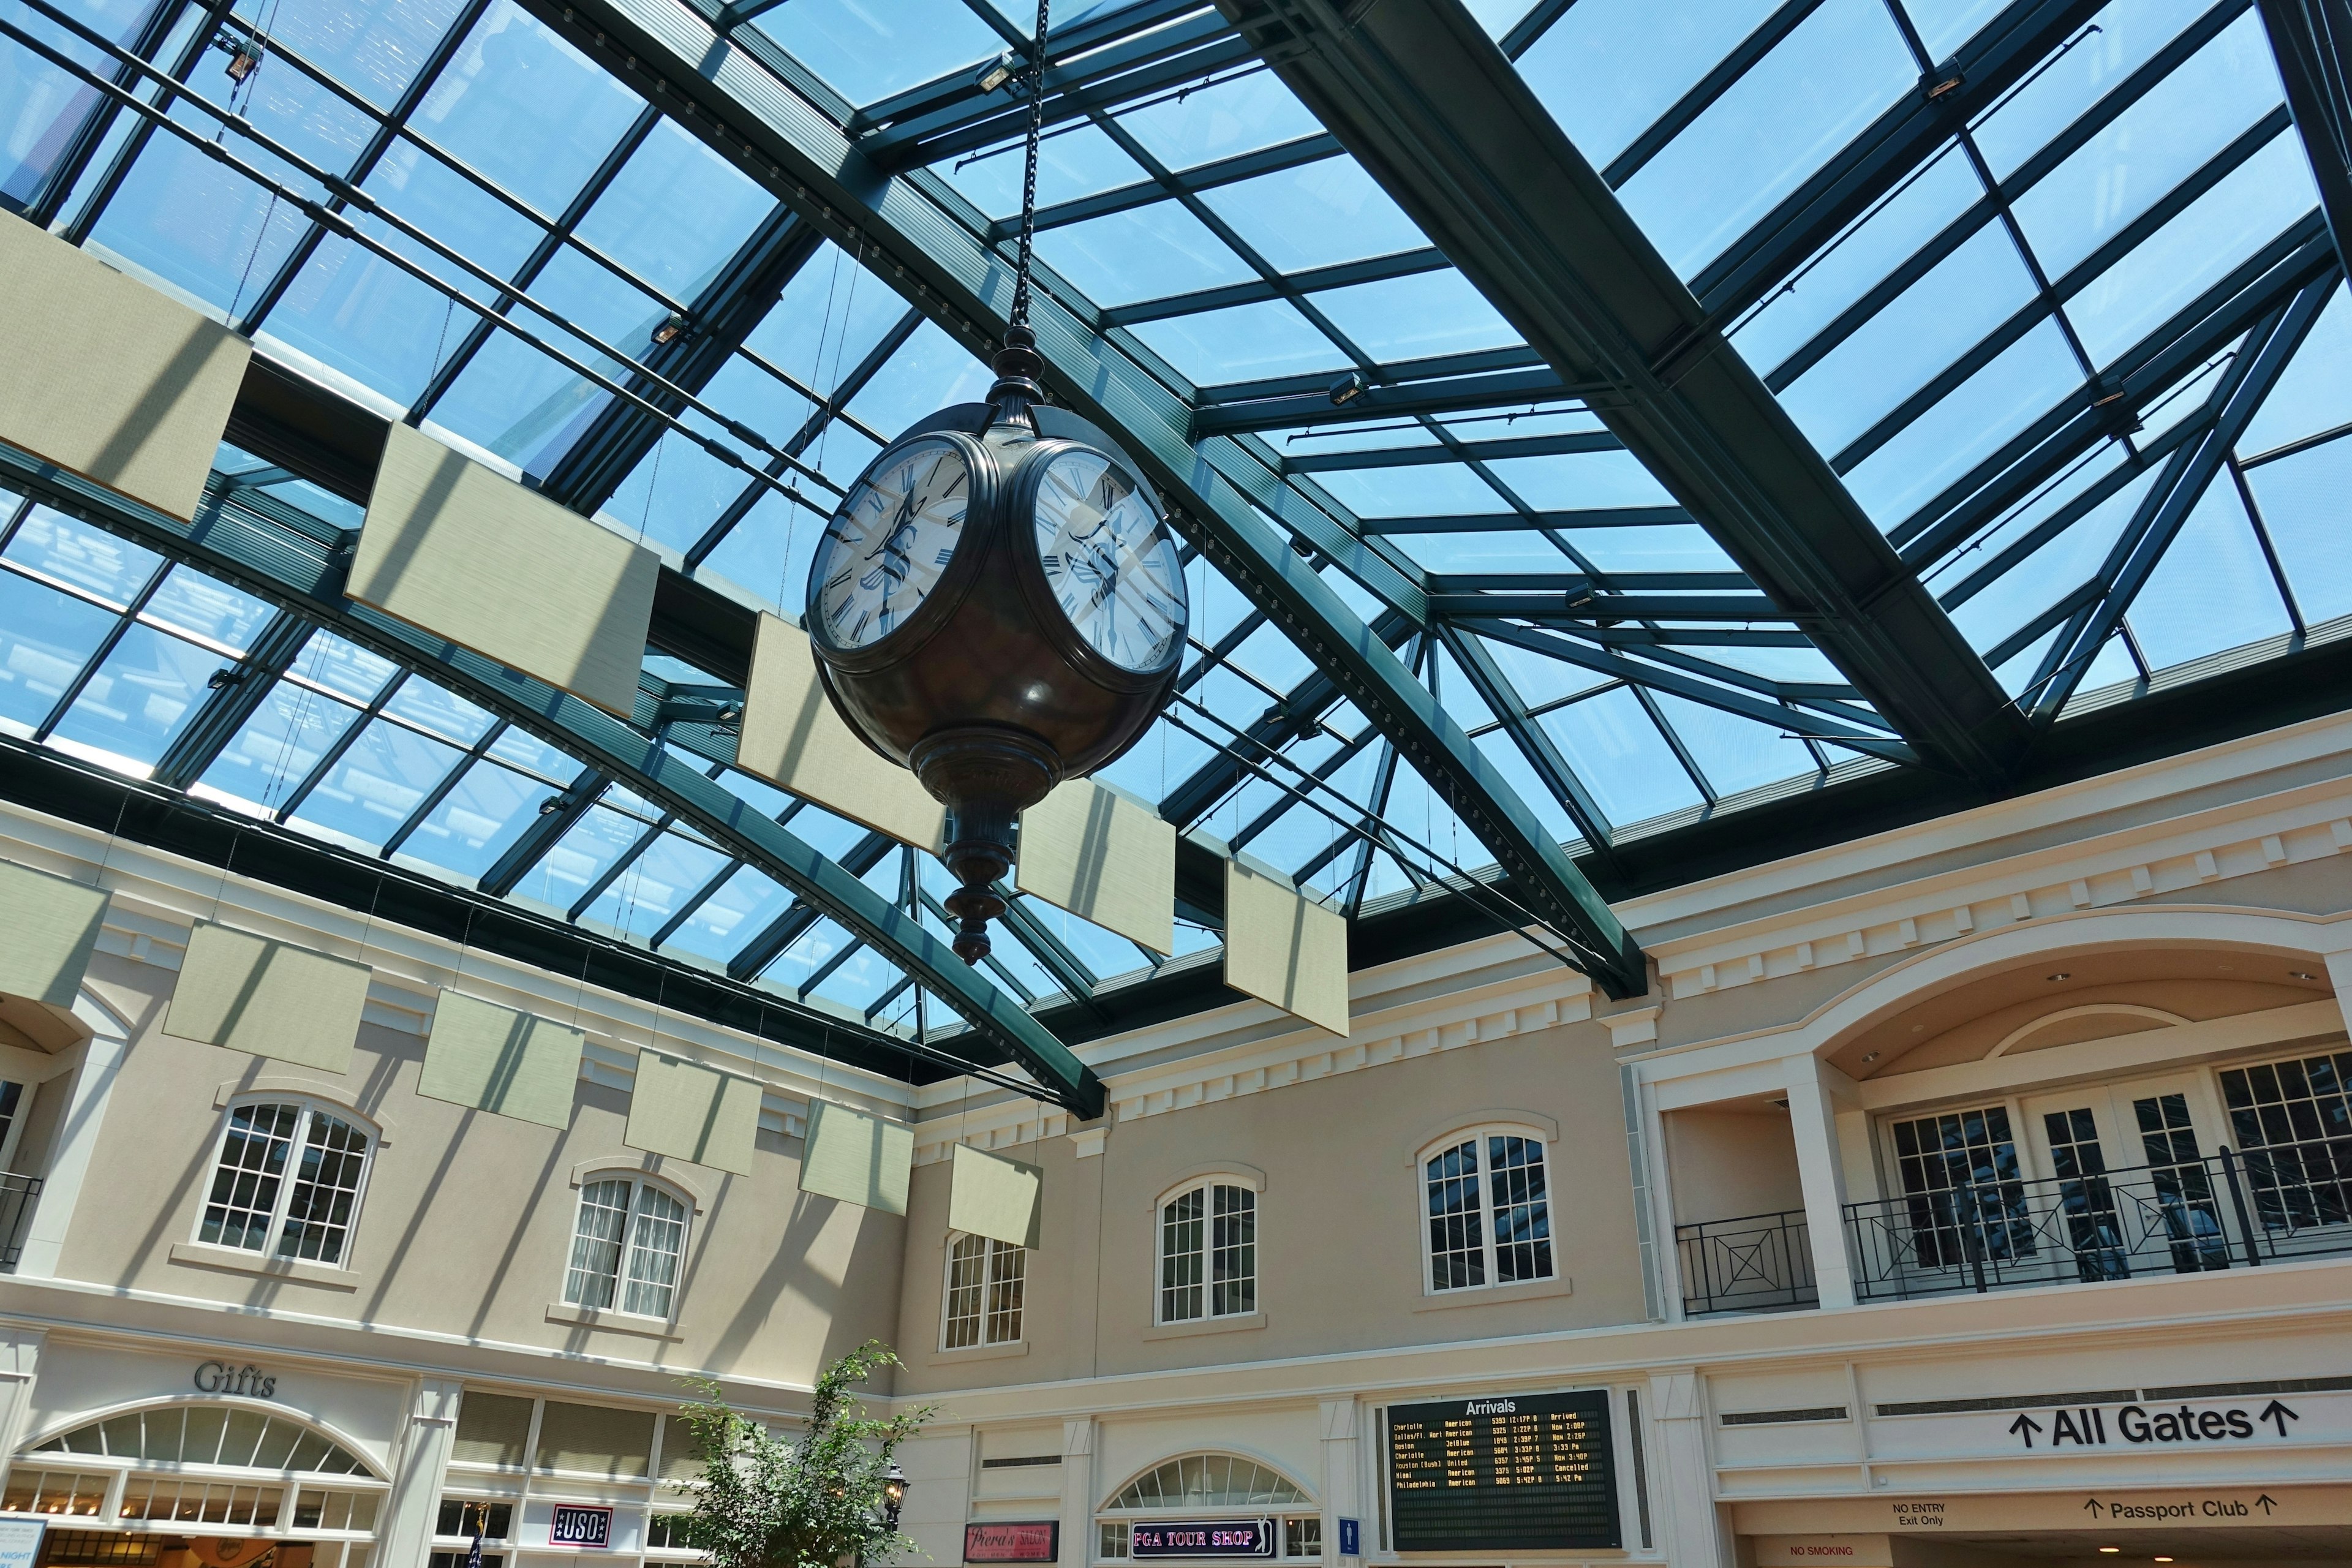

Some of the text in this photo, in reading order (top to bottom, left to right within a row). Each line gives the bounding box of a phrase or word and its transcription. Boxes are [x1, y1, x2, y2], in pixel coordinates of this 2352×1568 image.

[194, 1360, 277, 1398] Gifts
[1466, 1398, 1516, 1415] Arrivals
[2053, 1405, 2254, 1446] All Gates
[1555, 1463, 1589, 1472] Cancelled
[1893, 1503, 1945, 1513] NO ENTRY
[2111, 1500, 2248, 1521] Passport Club
[563, 1512, 599, 1540] USO
[1899, 1515, 1943, 1526] Exit Only
[970, 1527, 1046, 1551] Piera's SALON
[1133, 1530, 1253, 1547] PGA TOUR SHOP
[1790, 1547, 1853, 1555] NO SMOKING
